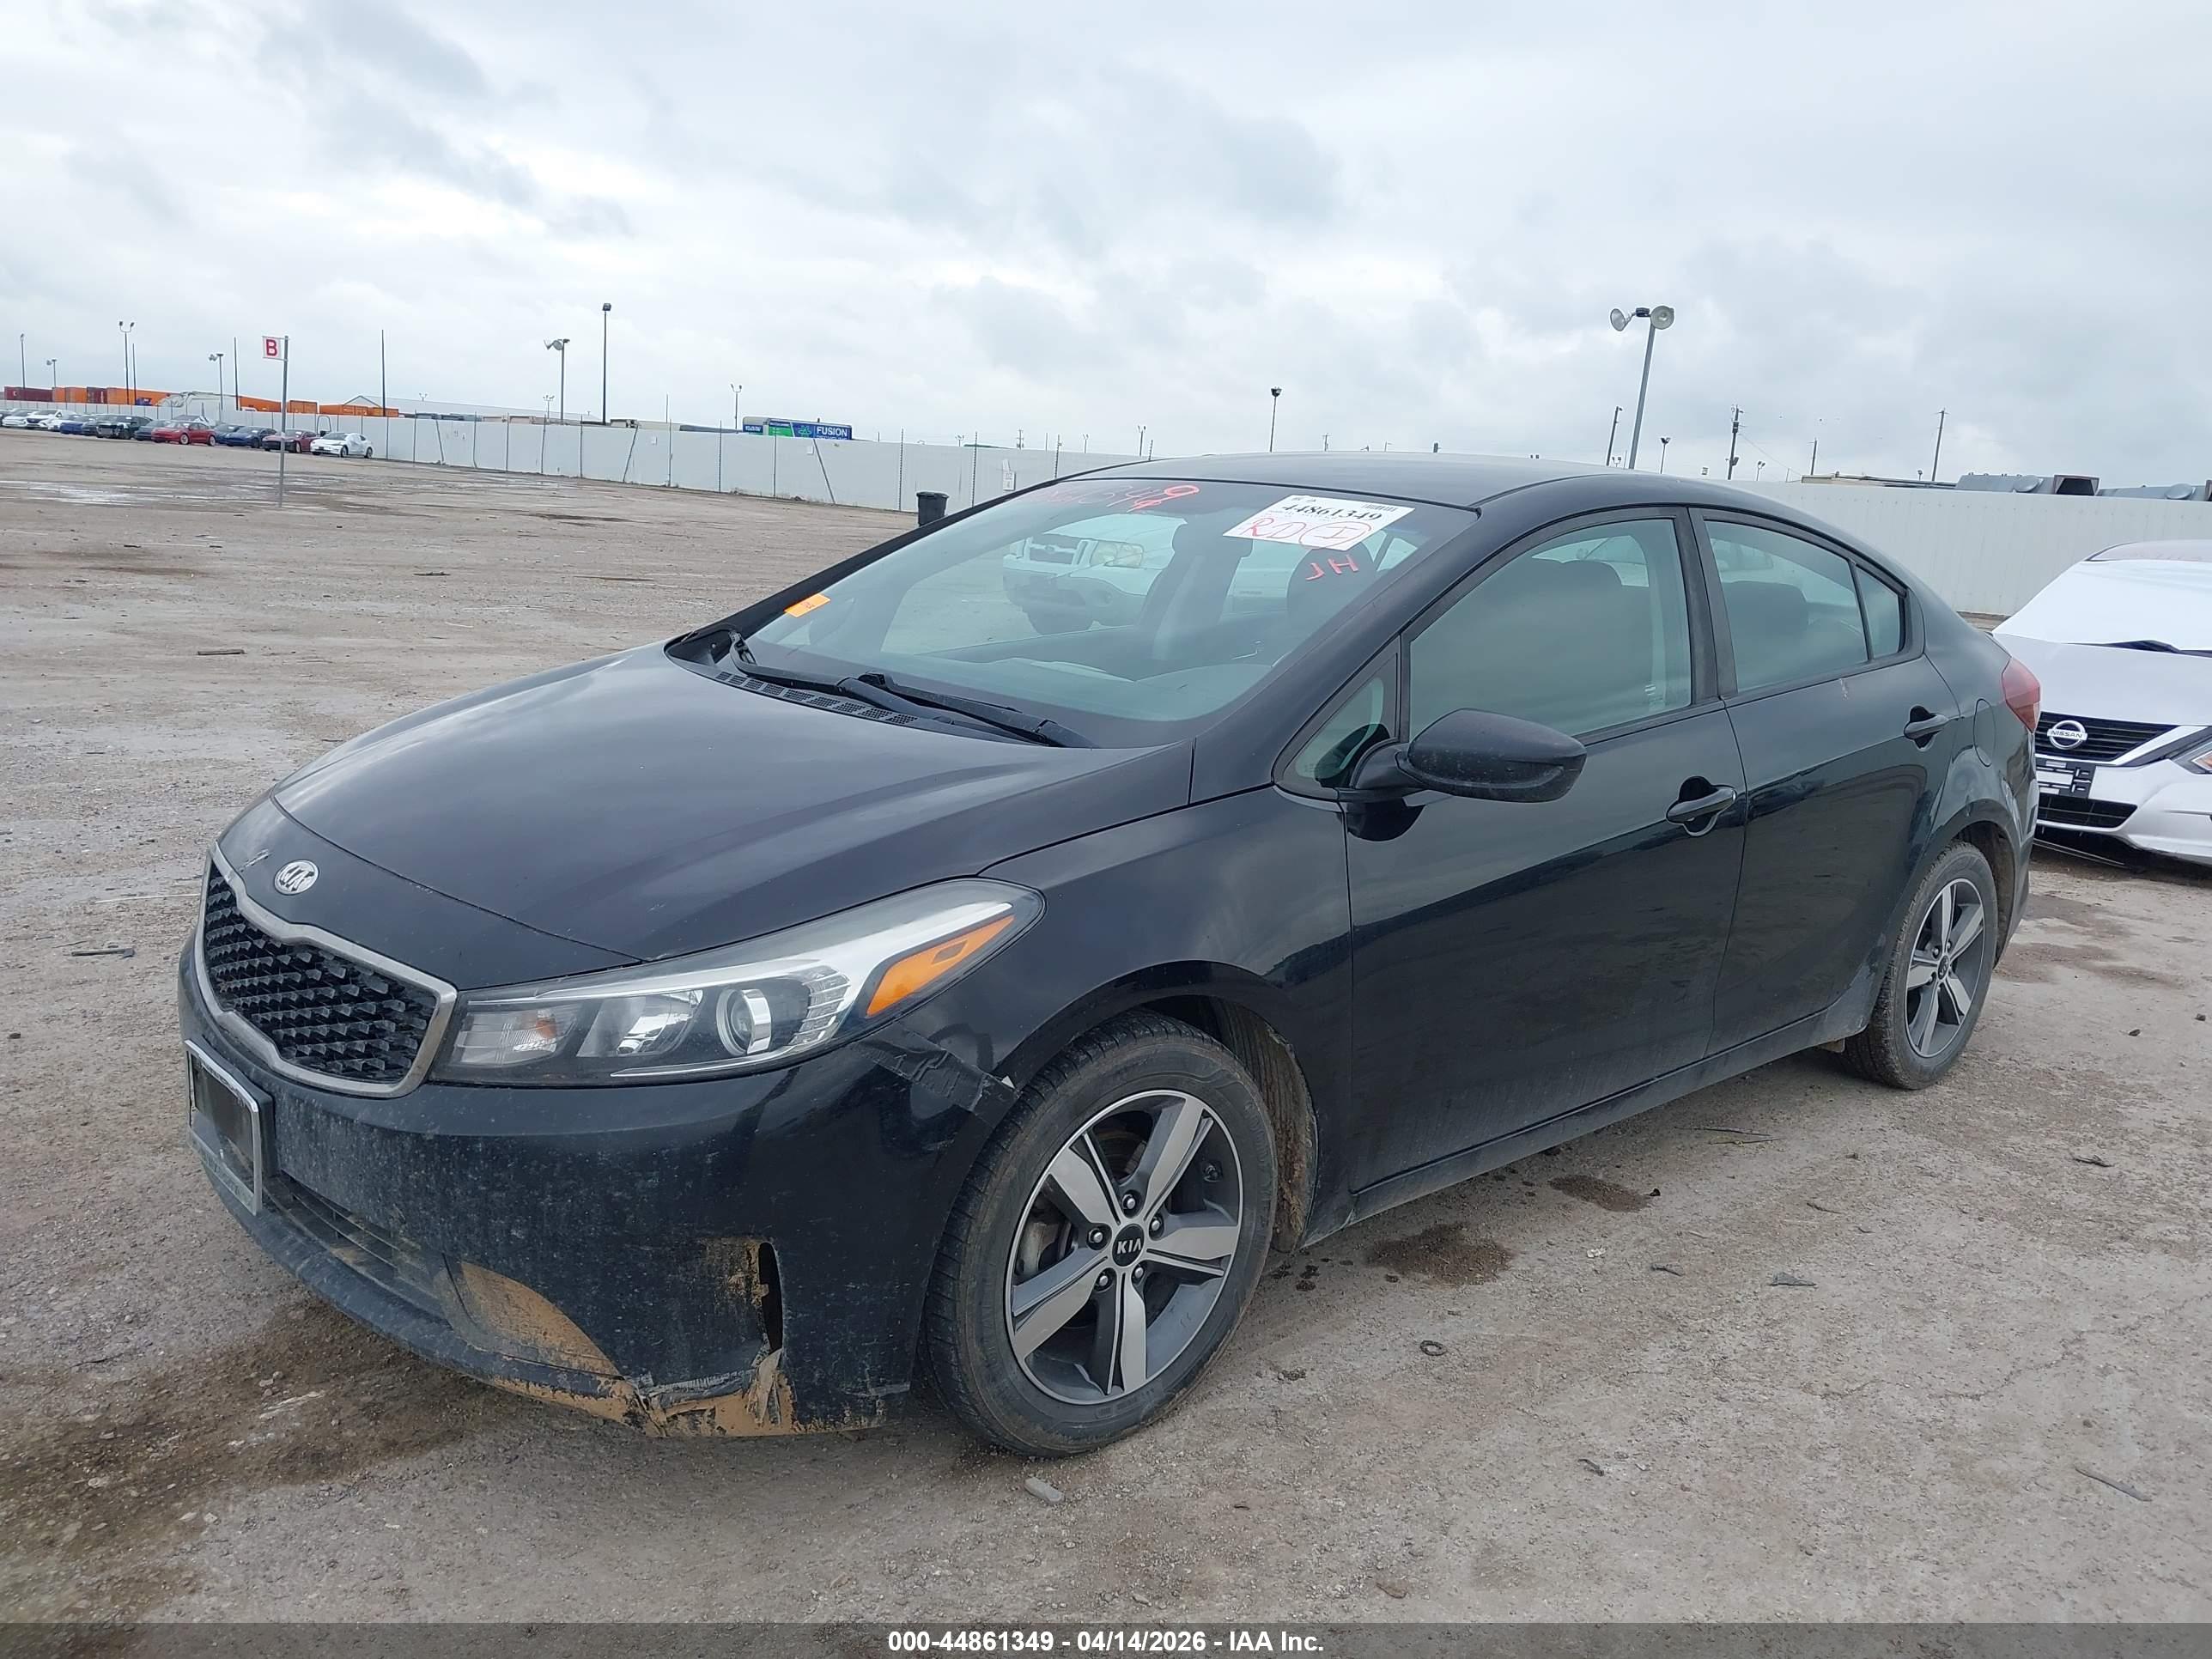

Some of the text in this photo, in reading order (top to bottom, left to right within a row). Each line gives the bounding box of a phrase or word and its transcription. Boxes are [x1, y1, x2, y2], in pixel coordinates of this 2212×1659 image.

[266, 338, 277, 356] B
[816, 425, 848, 437] FUSION
[1282, 503, 1382, 521] 44861349
[1117, 1238, 1141, 1255] KIA
